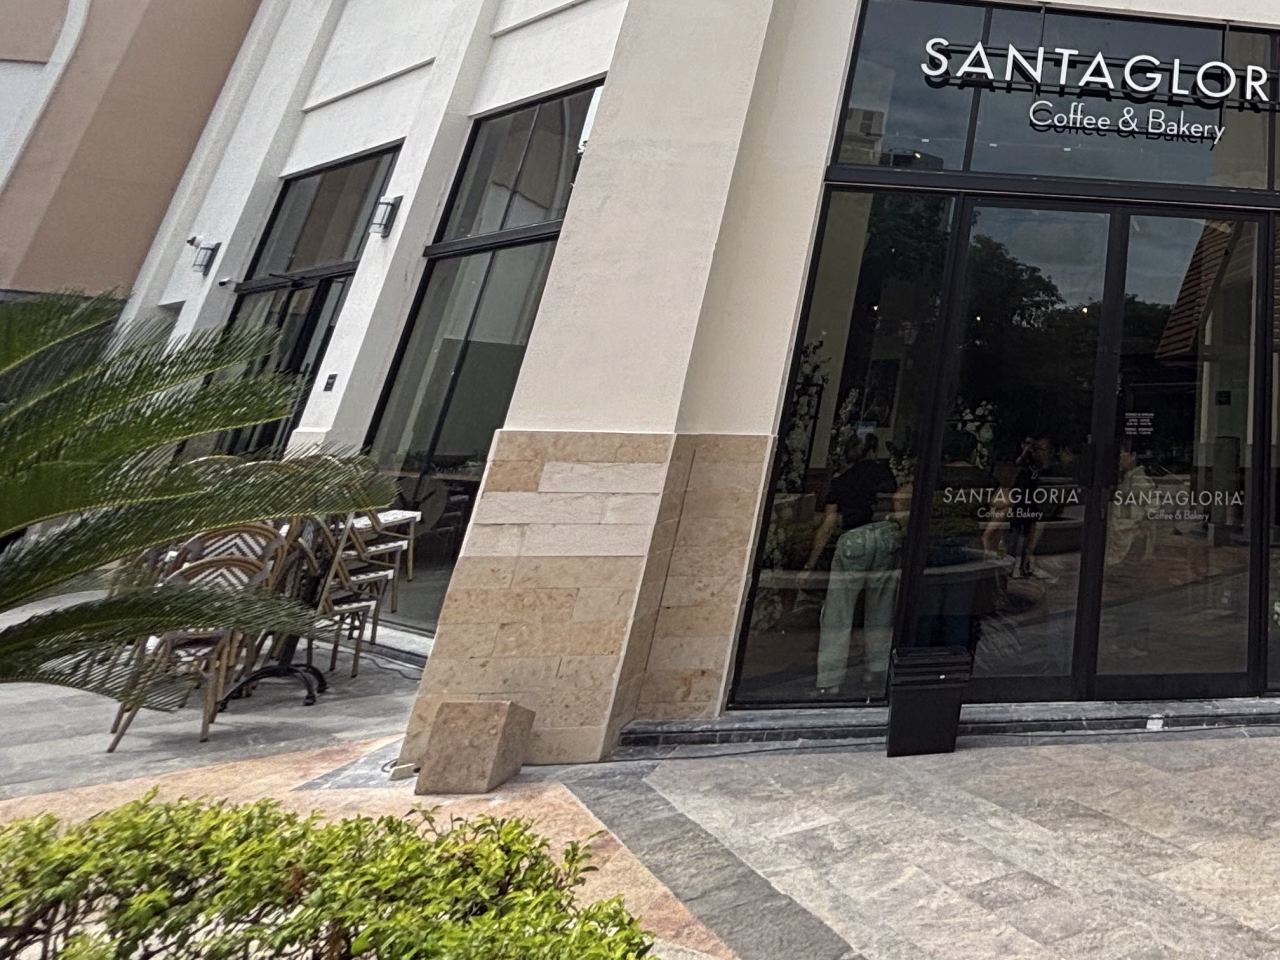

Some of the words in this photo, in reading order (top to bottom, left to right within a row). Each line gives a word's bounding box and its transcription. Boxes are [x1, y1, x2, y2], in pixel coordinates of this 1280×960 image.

[1028, 100, 1111, 133] Coffee
[1118, 107, 1138, 133] &
[1147, 109, 1225, 144] Bakery
[943, 487, 1081, 505] SANTAGLORIA
[1114, 490, 1245, 507] SANTAGLORIA
[977, 507, 1004, 519] Coffee
[1006, 508, 1014, 519] &
[1016, 507, 1044, 522] Bakery
[1147, 511, 1173, 522] Coffee
[1175, 511, 1182, 522] &
[1184, 511, 1210, 523] Bakery
